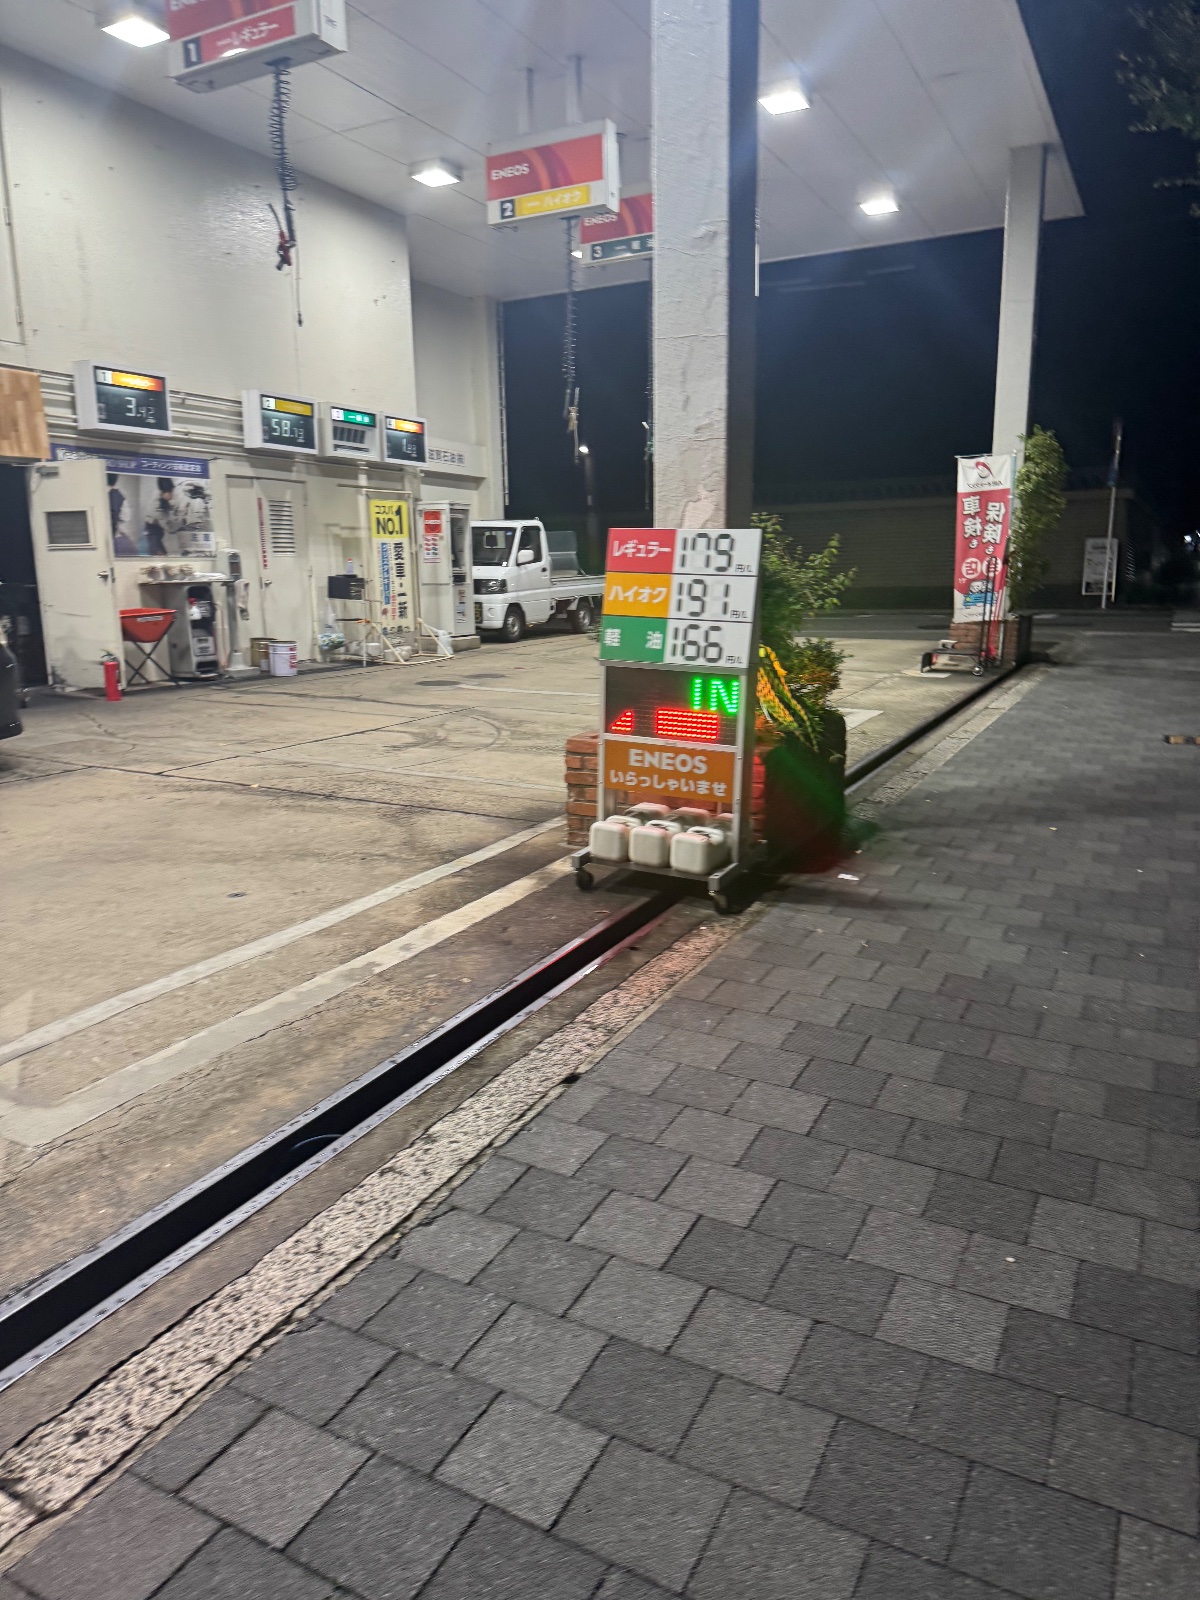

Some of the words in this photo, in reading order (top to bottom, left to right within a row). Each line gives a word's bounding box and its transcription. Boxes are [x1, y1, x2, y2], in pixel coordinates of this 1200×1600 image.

[188, 43, 198, 62] 1
[490, 163, 530, 180] ENEOS
[502, 200, 513, 218] 2
[583, 213, 618, 226] ENEOS
[593, 246, 602, 258] 3
[375, 505, 404, 535] NO.1
[612, 540, 672, 558] レギュラー
[679, 532, 735, 572] 179
[607, 586, 669, 604] ハイオク
[676, 578, 730, 617] 191
[671, 624, 722, 663] 166
[691, 677, 740, 714] IN
[628, 748, 709, 775] ENEOS
[609, 769, 728, 797] いらっしゃいませ
